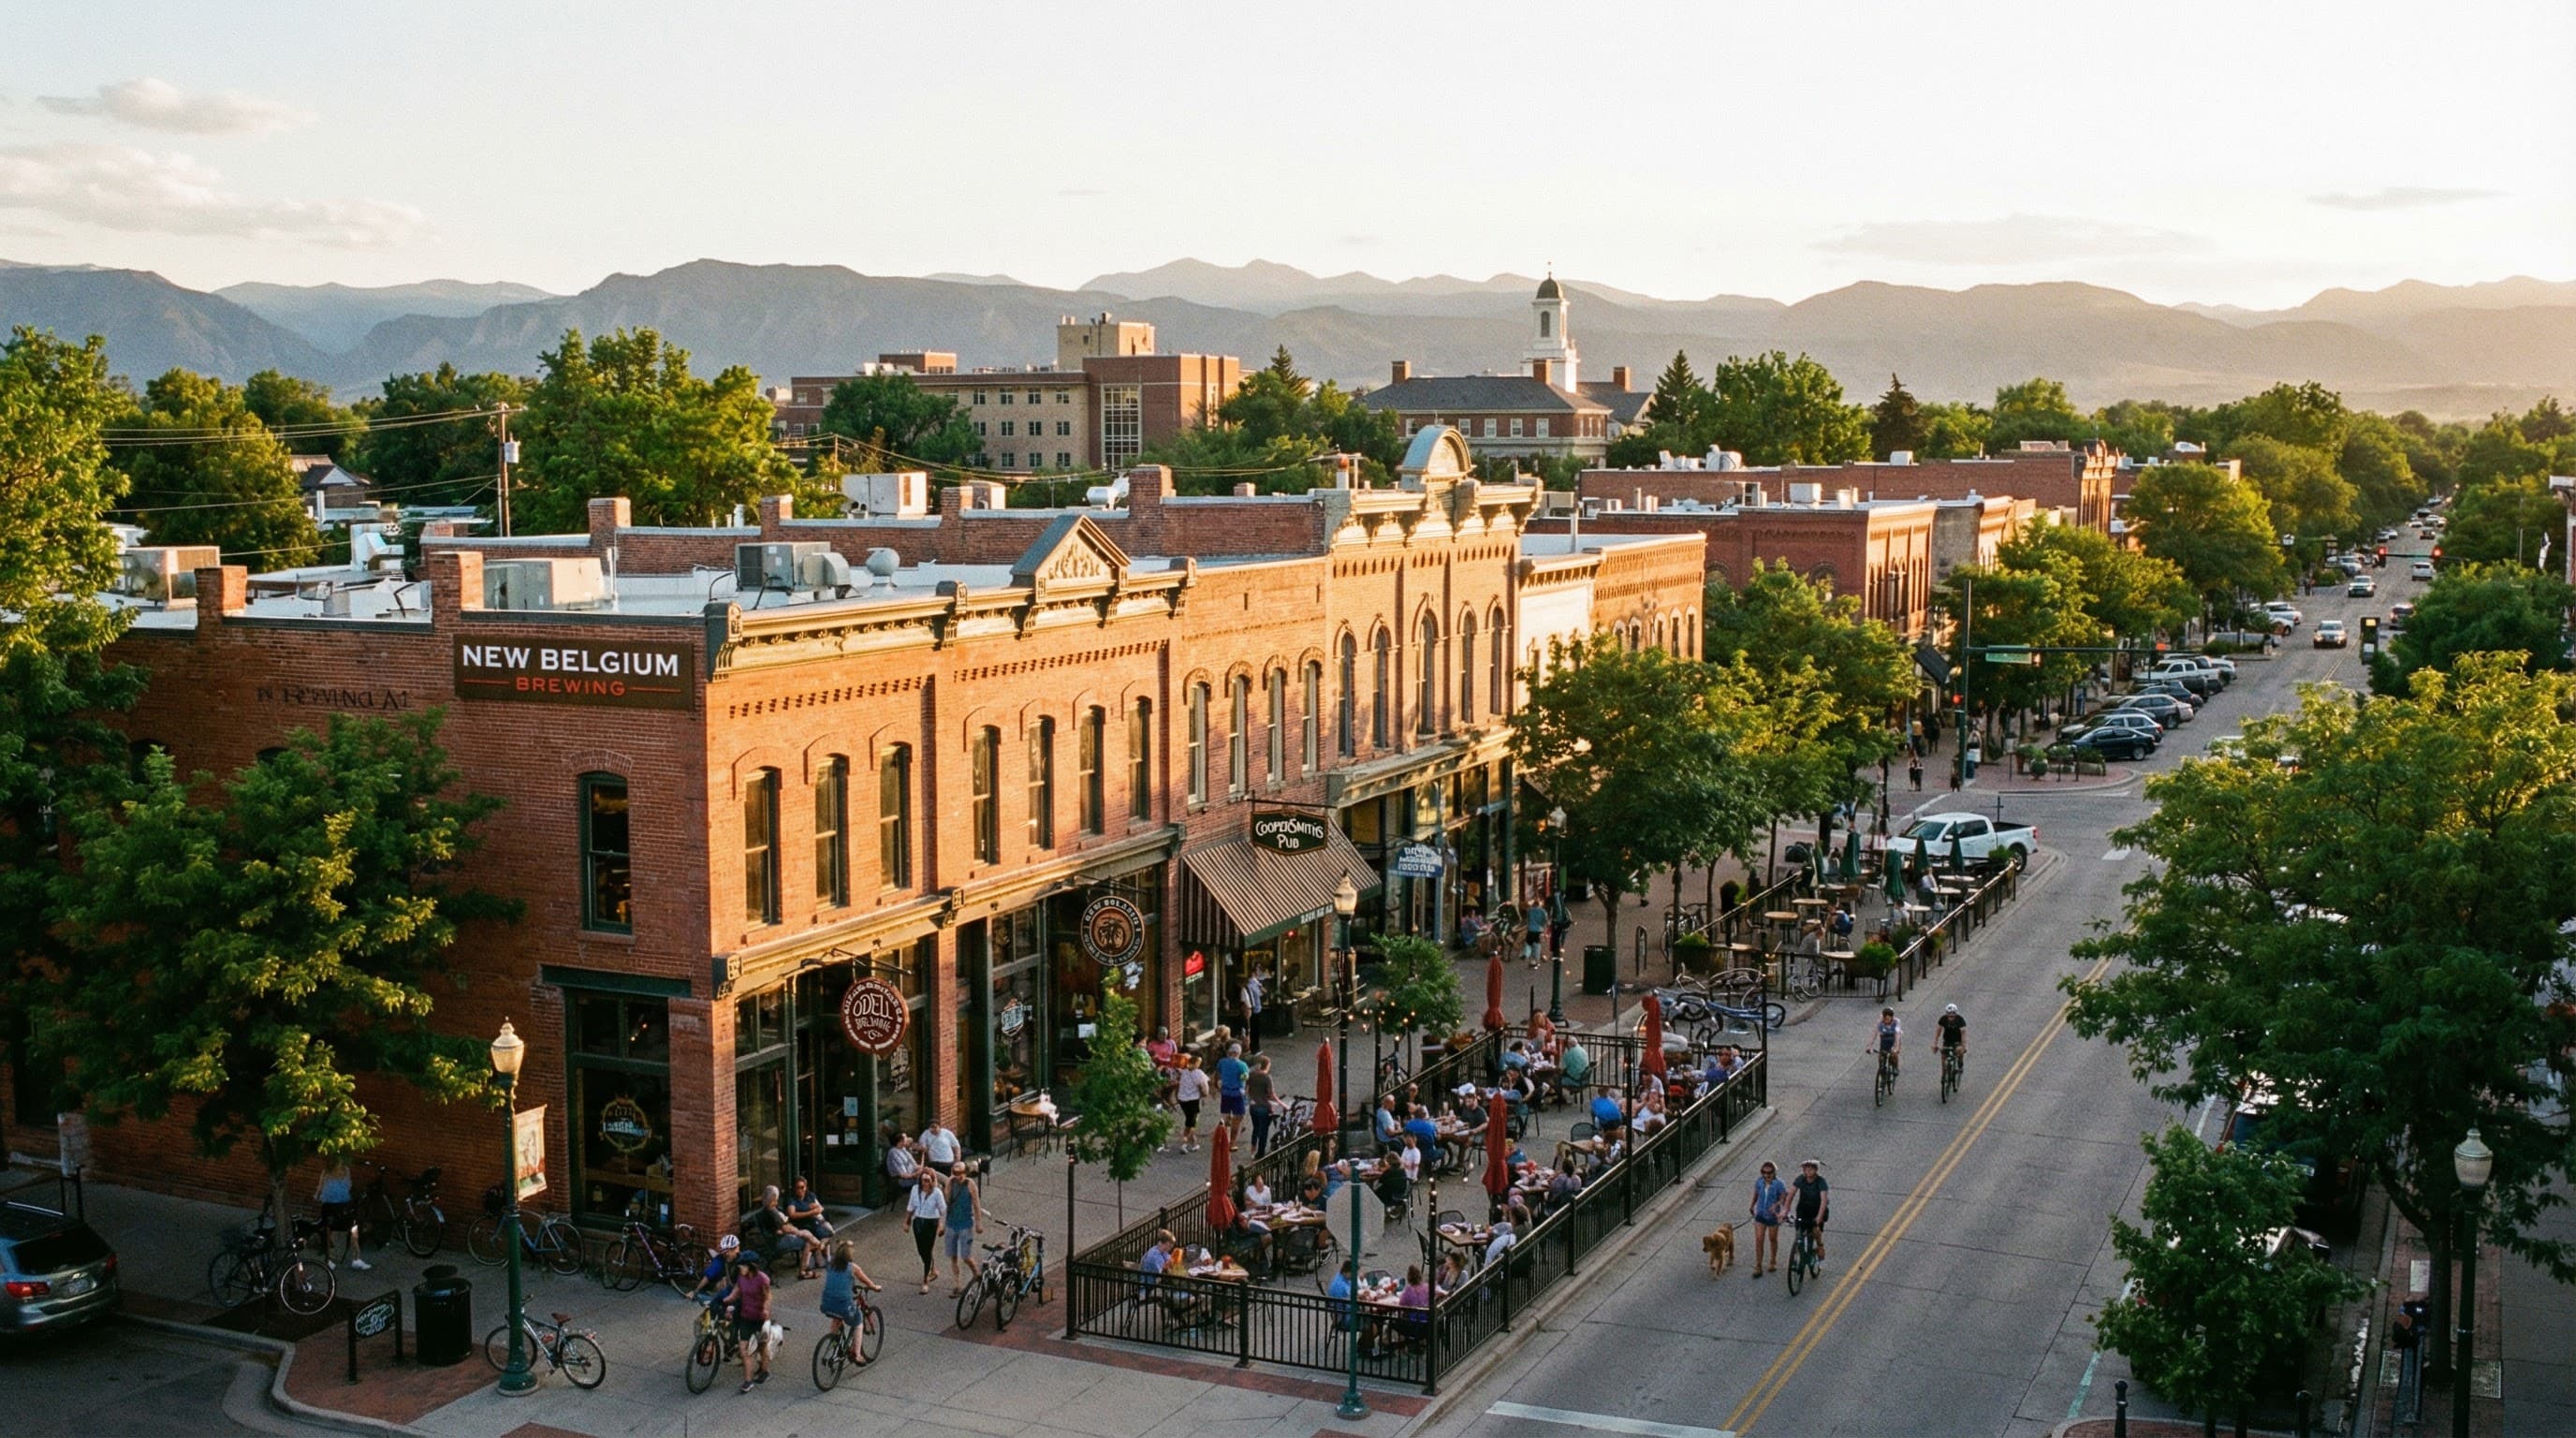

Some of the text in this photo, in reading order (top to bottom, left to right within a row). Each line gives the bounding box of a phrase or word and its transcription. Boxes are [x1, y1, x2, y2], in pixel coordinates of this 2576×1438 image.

[462, 645, 680, 677] NEW BELGIUM
[516, 677, 626, 697] BREWING
[853, 992, 894, 1020] ODELL
